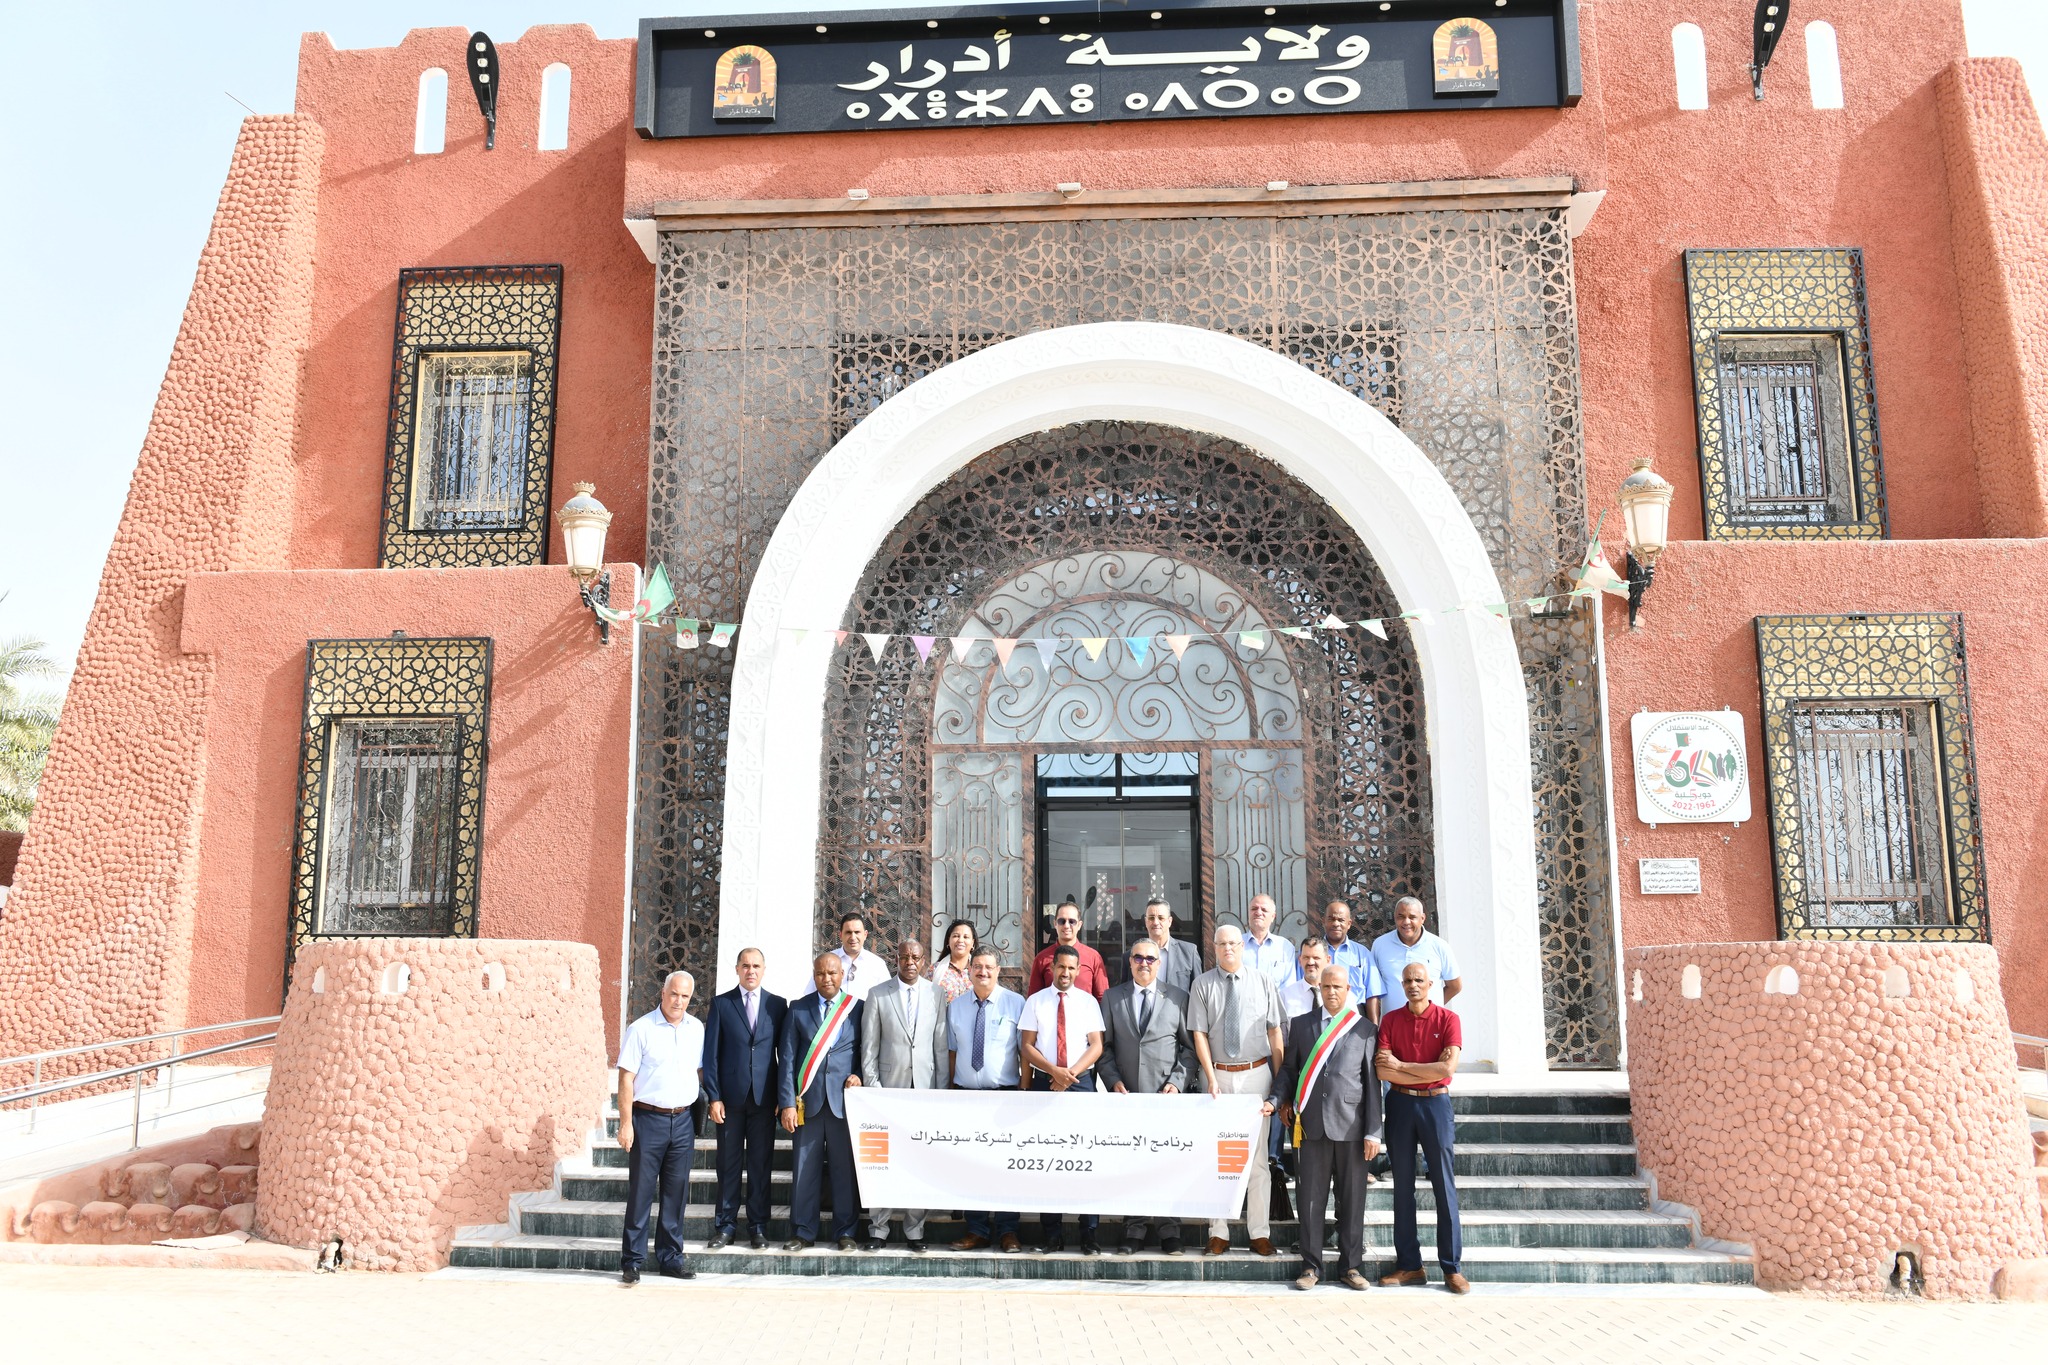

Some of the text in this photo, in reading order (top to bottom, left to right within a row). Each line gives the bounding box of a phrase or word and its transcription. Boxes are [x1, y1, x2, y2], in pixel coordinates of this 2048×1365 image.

[836, 24, 1371, 91] ولاية أدرار
[910, 1130, 1193, 1152] برنامج الإستثمار الإجتماعي لشركة سونطراك
[1007, 1158, 1093, 1173] 2023/2022
